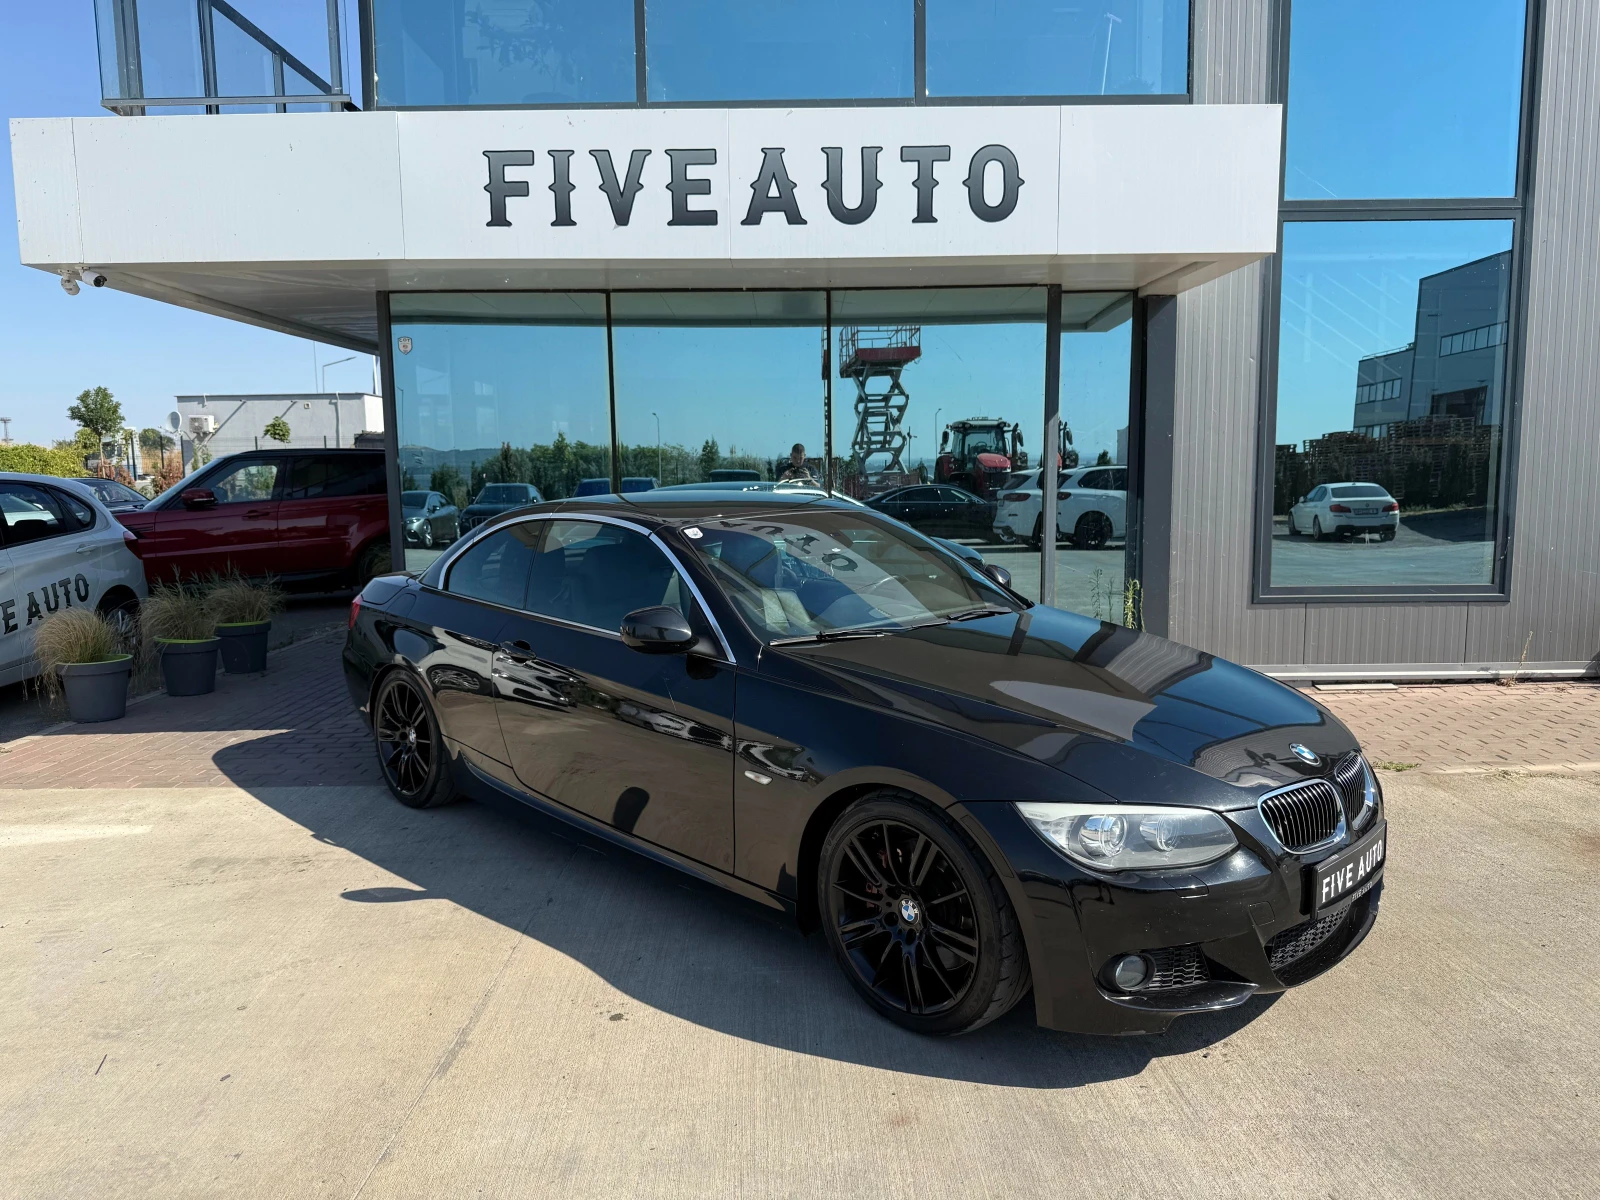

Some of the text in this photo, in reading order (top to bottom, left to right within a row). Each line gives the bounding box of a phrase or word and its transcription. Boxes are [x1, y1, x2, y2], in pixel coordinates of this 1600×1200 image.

[26, 573, 89, 625] AUTO
[1321, 839, 1383, 904] FIVE AUTO
